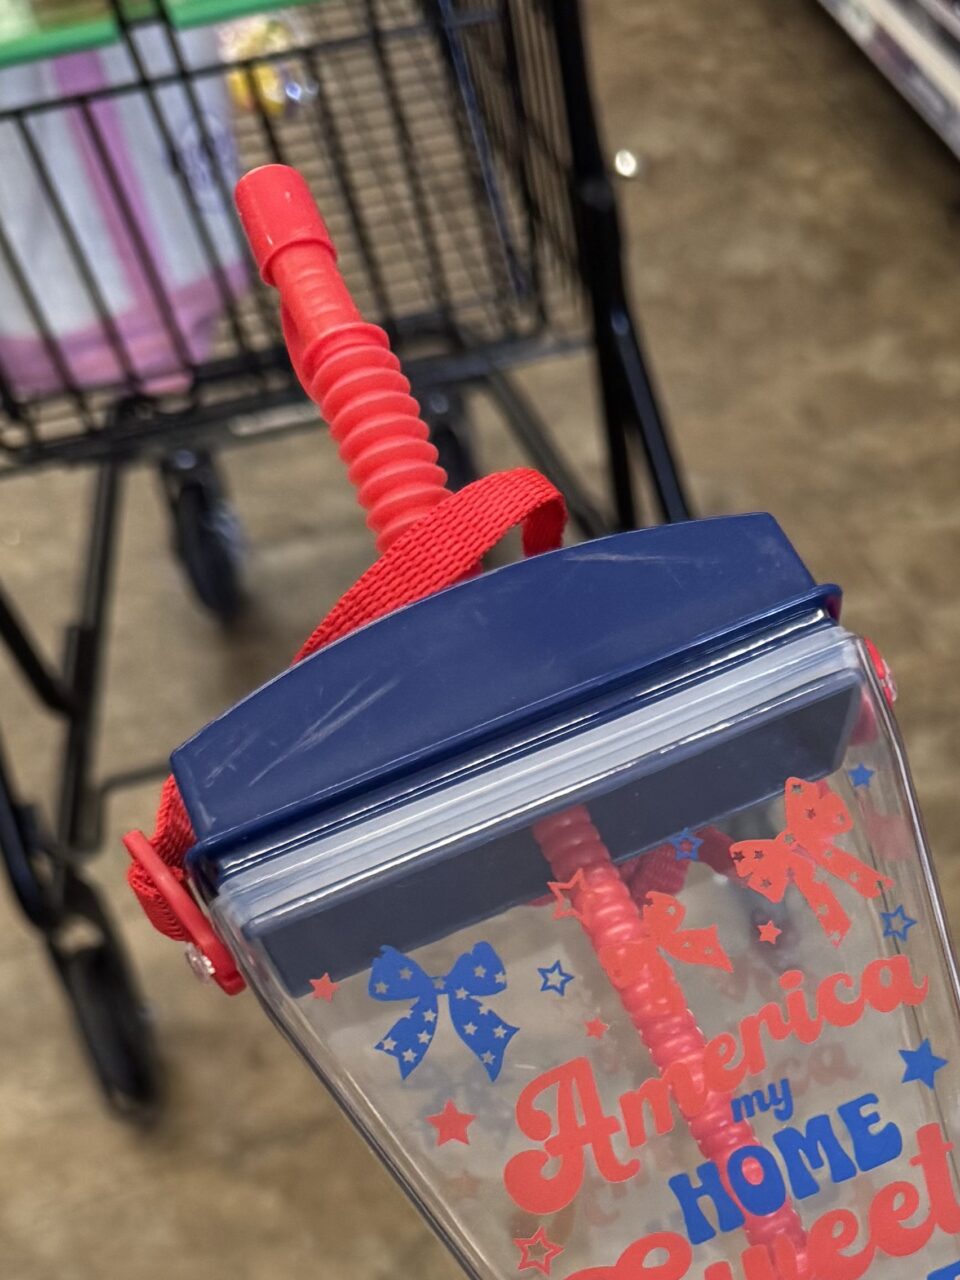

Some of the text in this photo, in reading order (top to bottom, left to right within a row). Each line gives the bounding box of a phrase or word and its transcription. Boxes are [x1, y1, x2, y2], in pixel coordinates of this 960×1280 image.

[504, 954, 929, 1213] America
[731, 1078, 793, 1124] my
[669, 1093, 903, 1245] HOME
